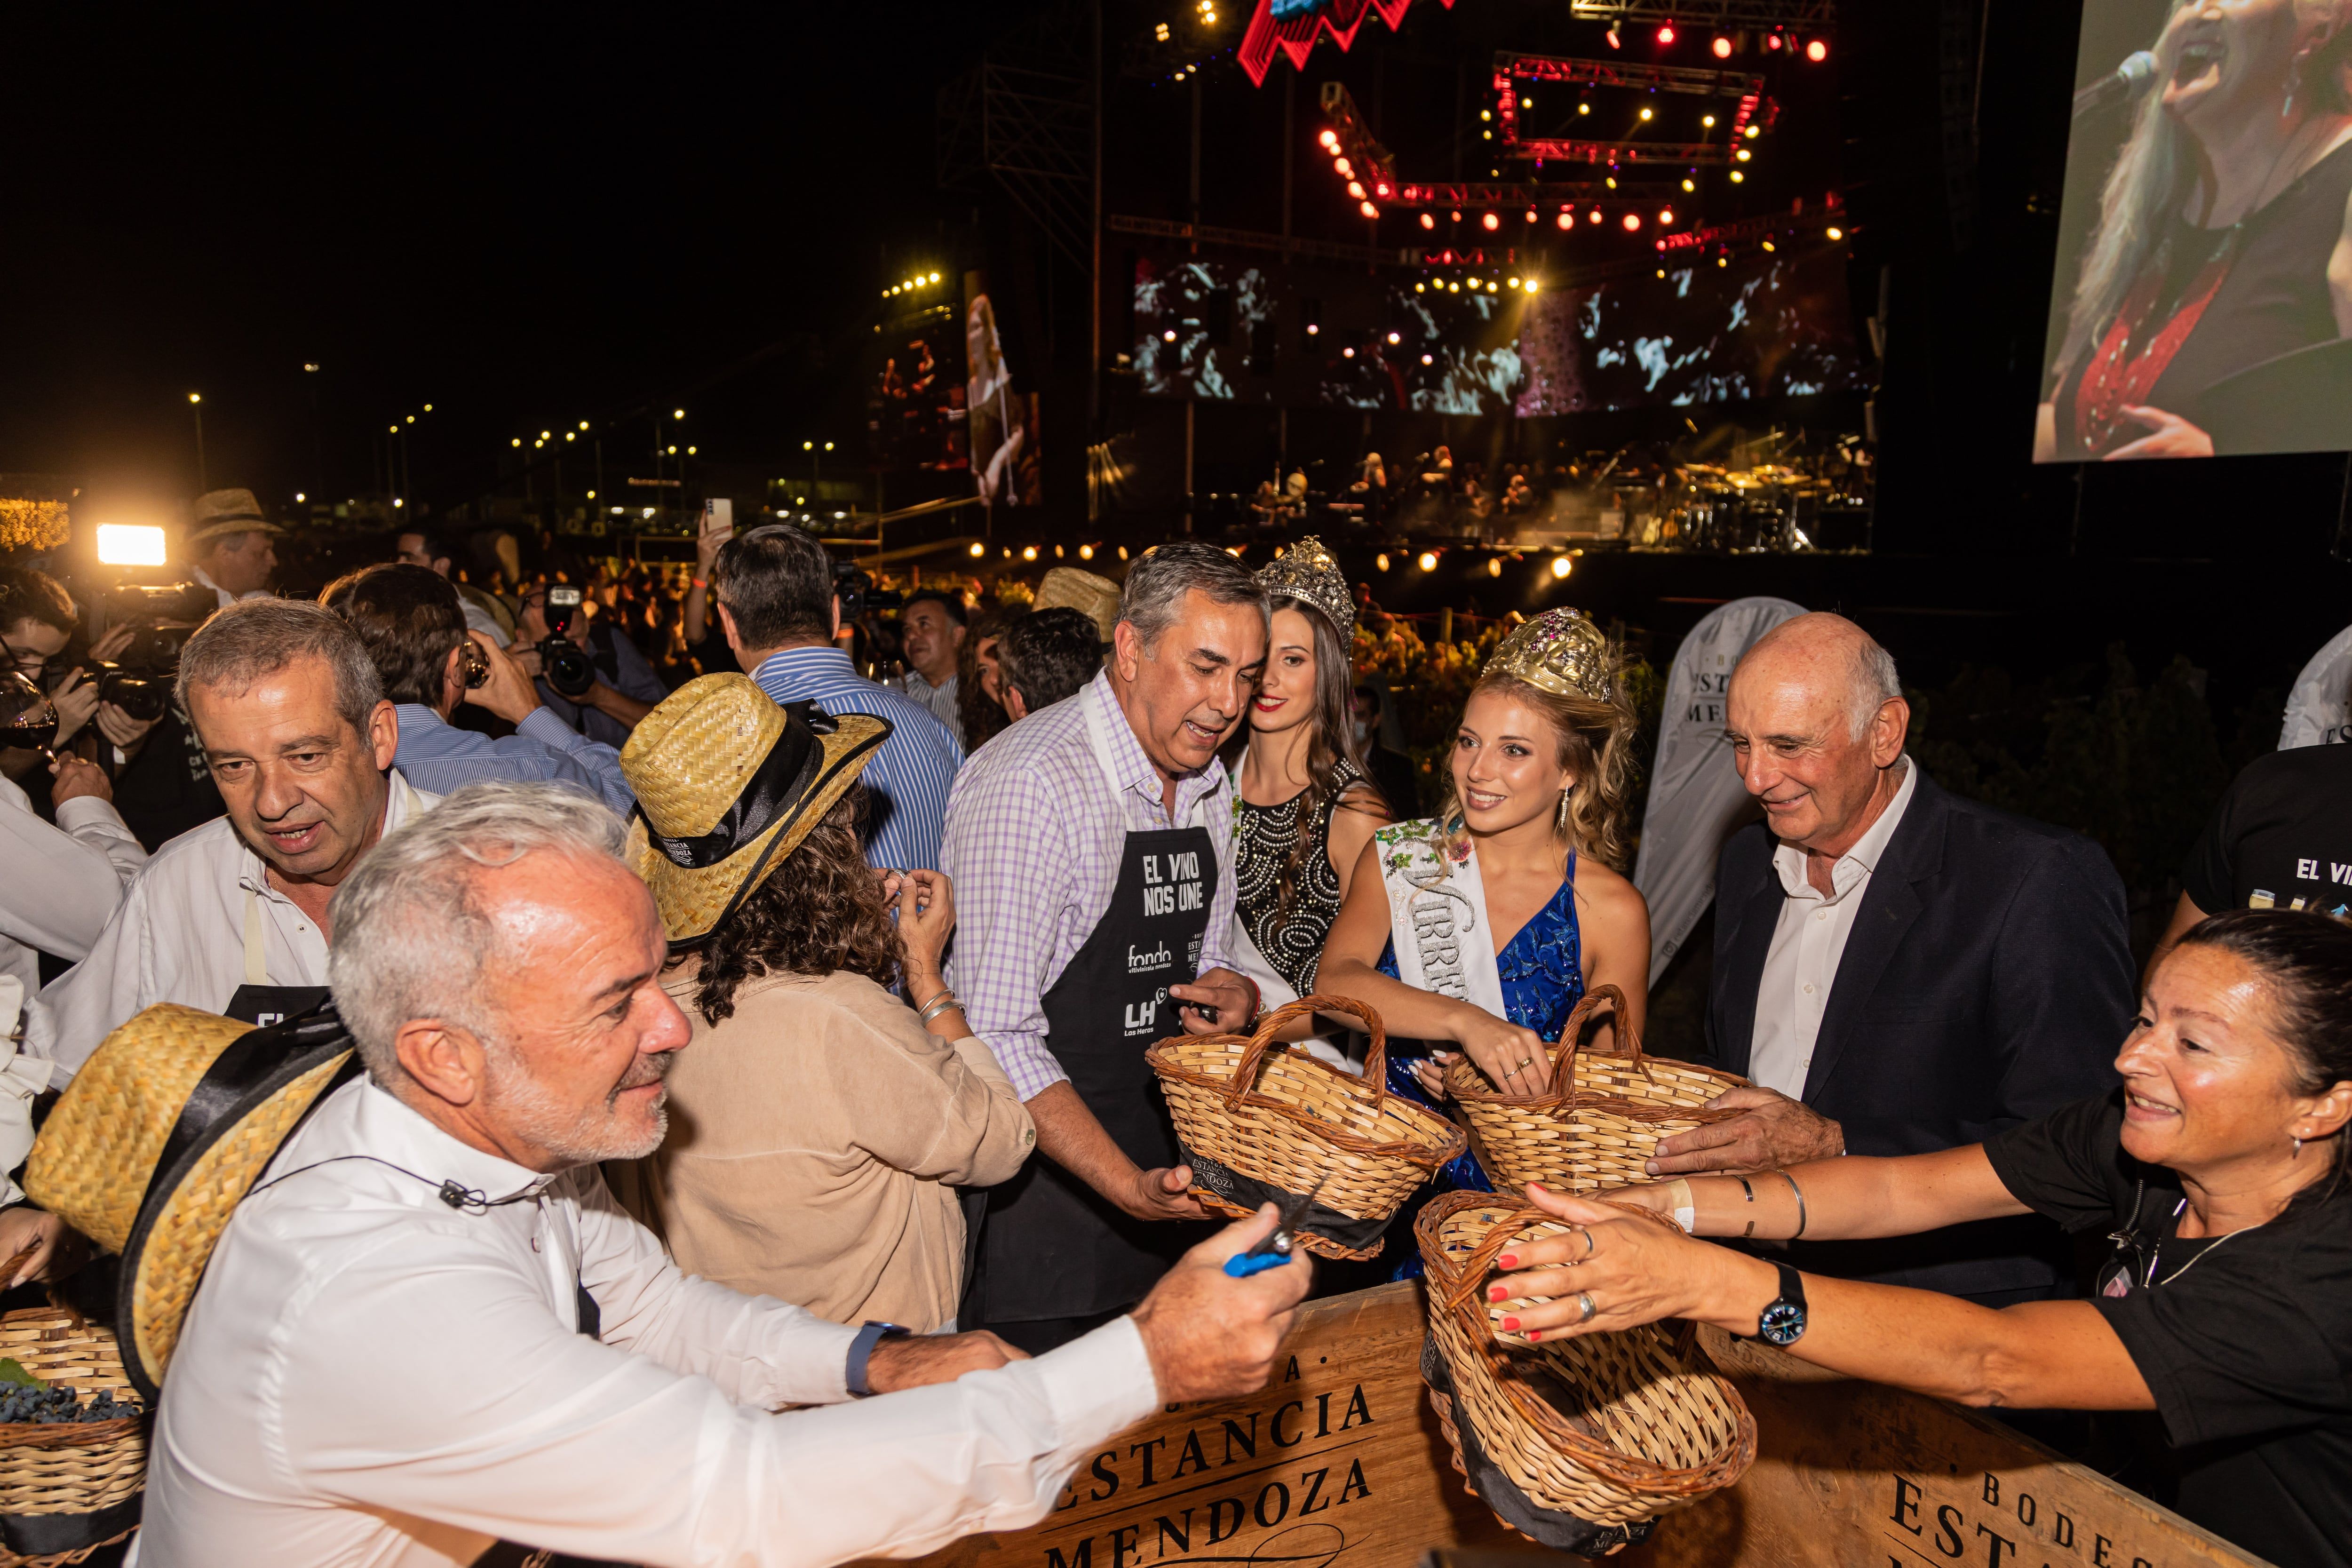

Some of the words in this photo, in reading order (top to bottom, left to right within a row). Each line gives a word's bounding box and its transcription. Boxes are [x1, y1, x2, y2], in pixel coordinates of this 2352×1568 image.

[1143, 855, 1163, 884] EL
[1168, 852, 1200, 881] VINO
[2296, 858, 2320, 880] EL
[1144, 885, 1175, 916] NOS
[1179, 882, 1203, 911] UNE
[1128, 941, 1171, 967] fondo
[1128, 964, 1154, 973] vitivinícola
[1125, 1000, 1156, 1028] LH
[1889, 1472, 2052, 1568] EST
